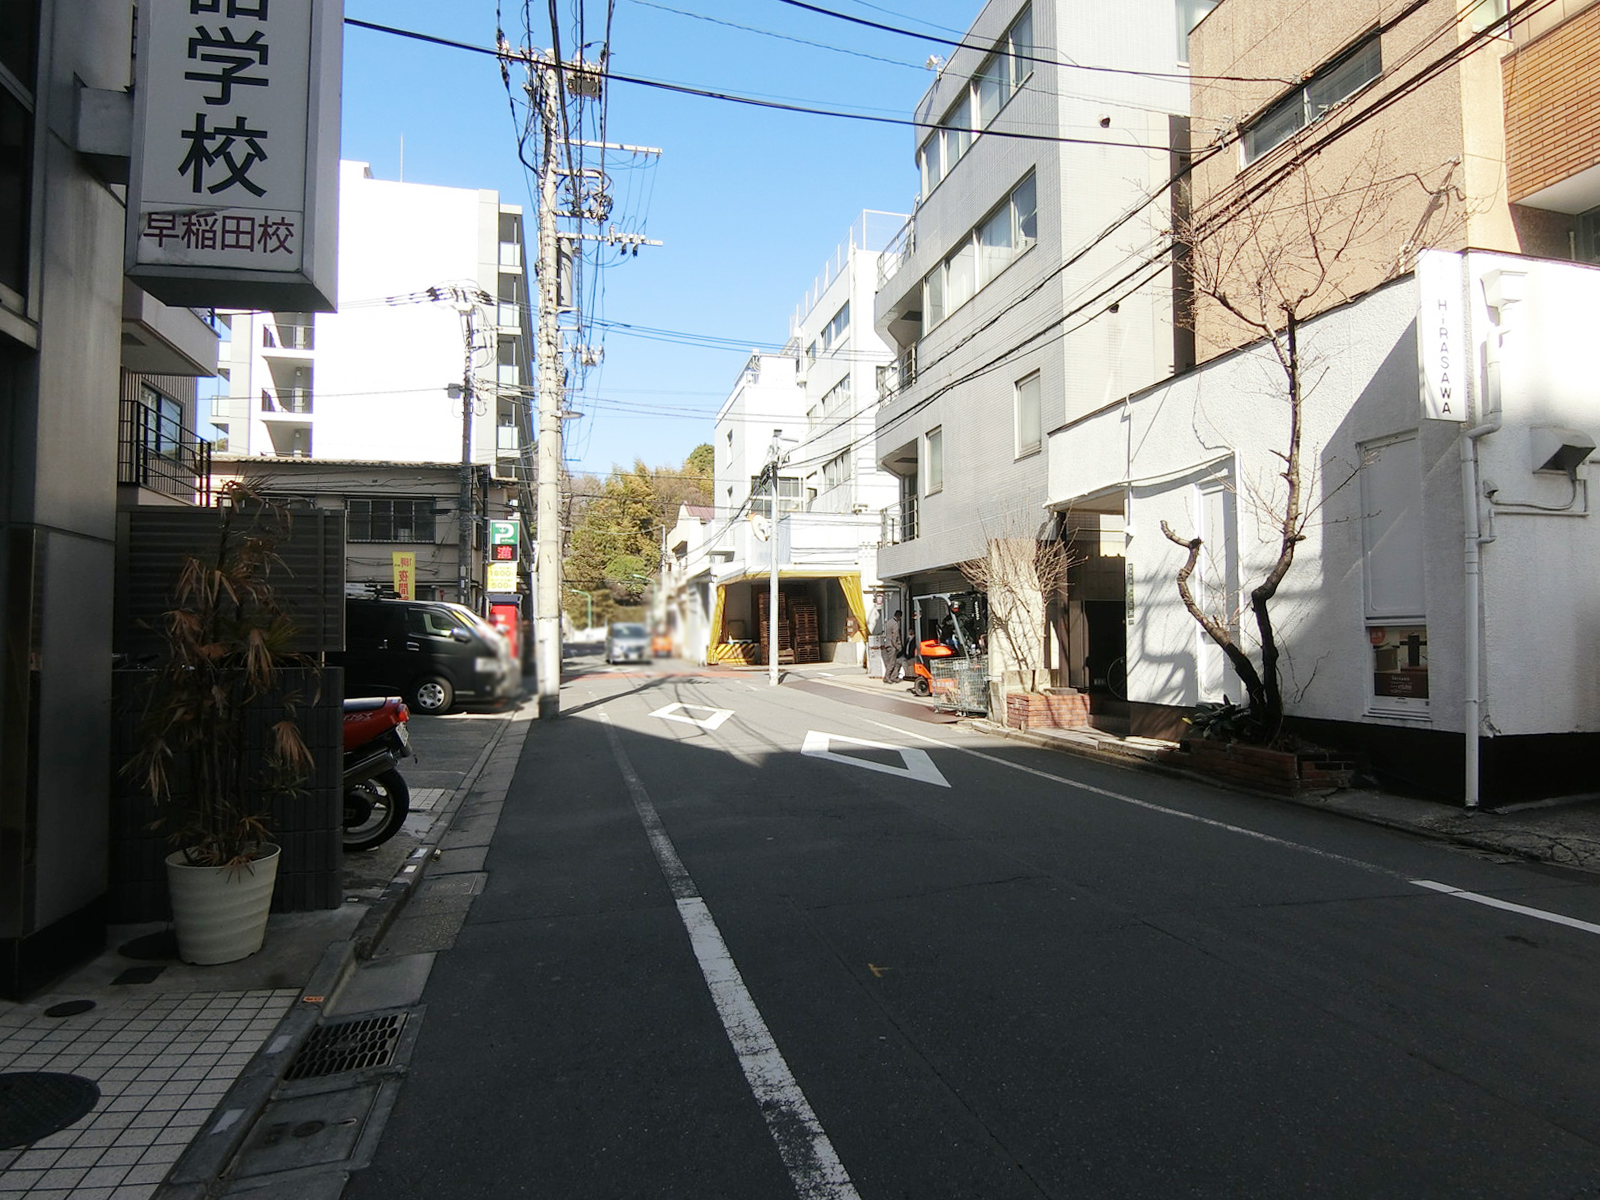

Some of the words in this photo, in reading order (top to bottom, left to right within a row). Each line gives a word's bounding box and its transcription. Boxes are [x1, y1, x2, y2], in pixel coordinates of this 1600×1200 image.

[143, 211, 295, 254] 早稲田校
[1438, 299, 1452, 415] HIRASAWA
